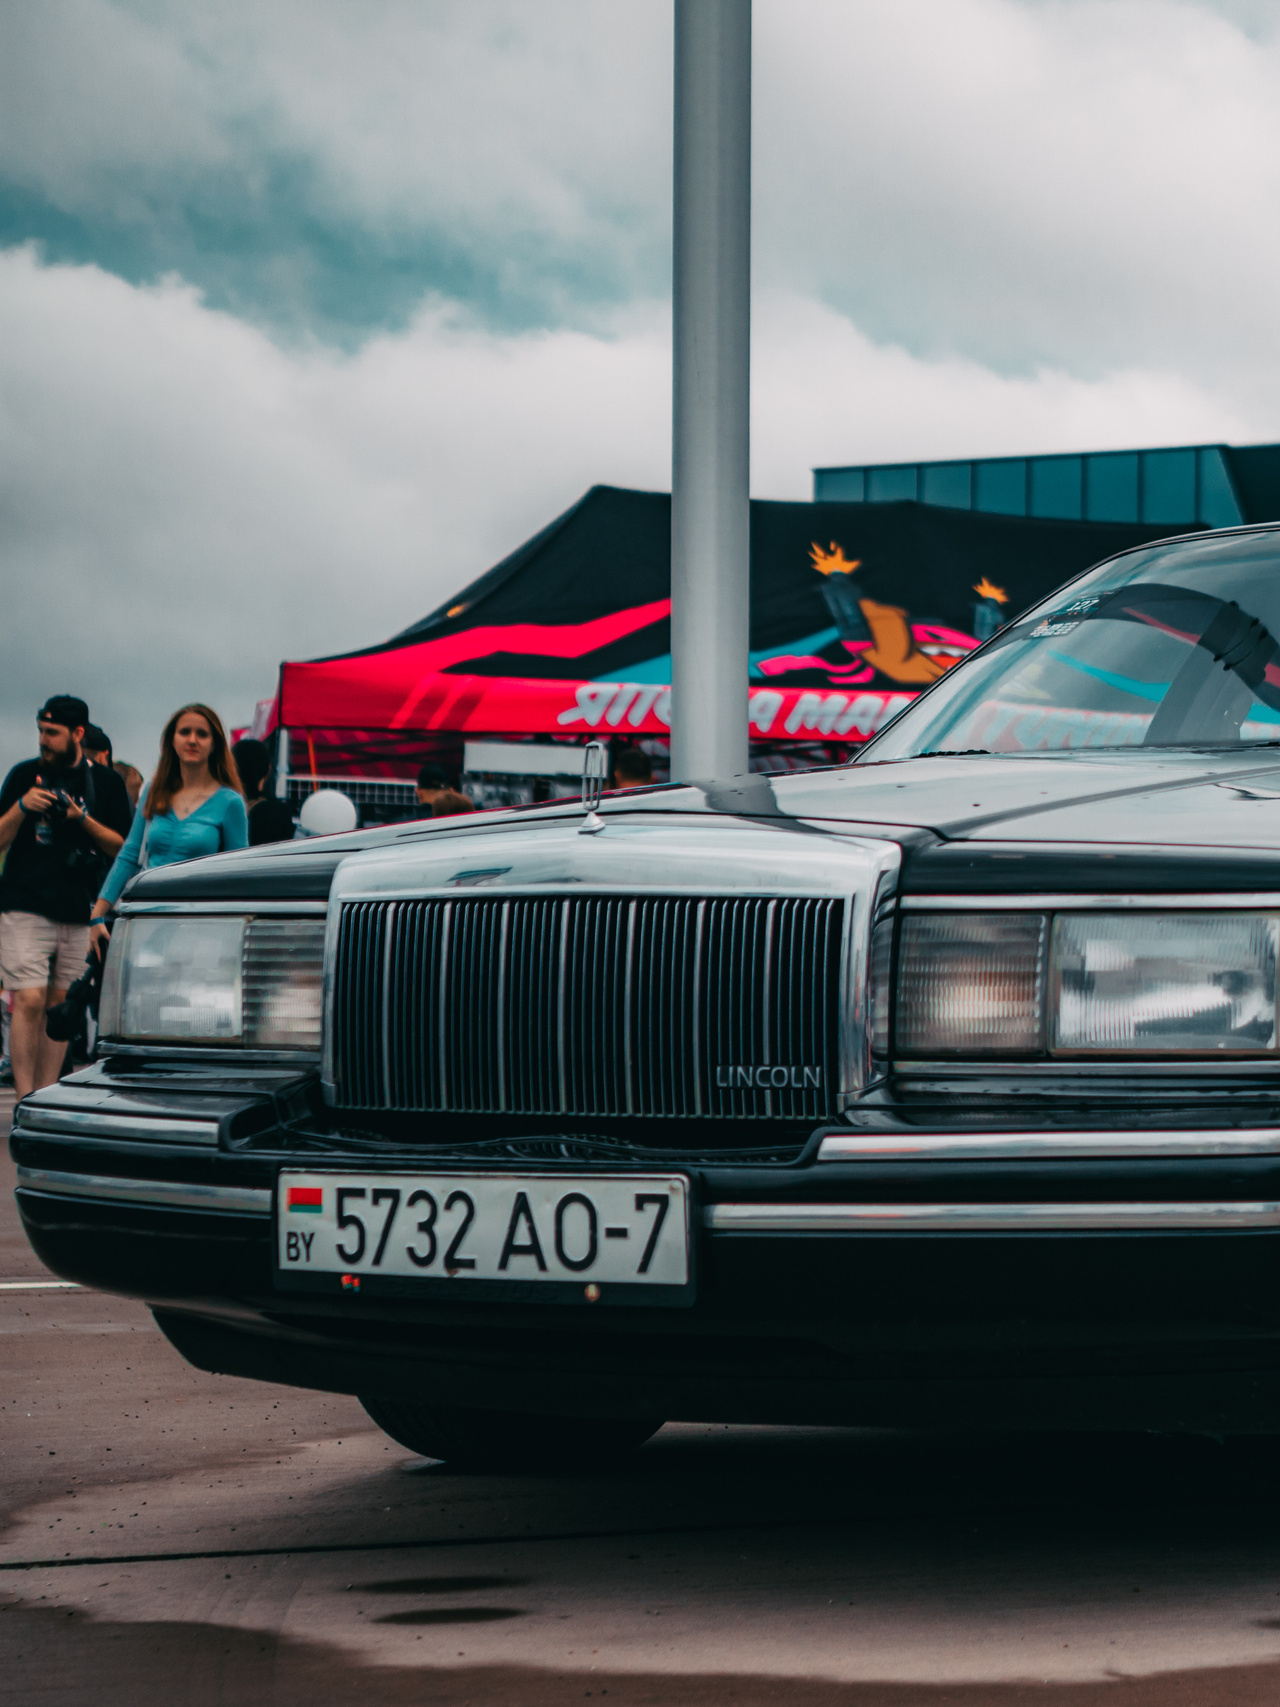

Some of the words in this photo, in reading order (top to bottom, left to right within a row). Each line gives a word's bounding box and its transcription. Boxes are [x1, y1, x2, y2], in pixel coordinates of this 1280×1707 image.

[716, 1065, 821, 1088] LINCOLN
[286, 1231, 316, 1263] BY
[335, 1187, 476, 1271] 5732
[497, 1191, 670, 1275] AO-7
